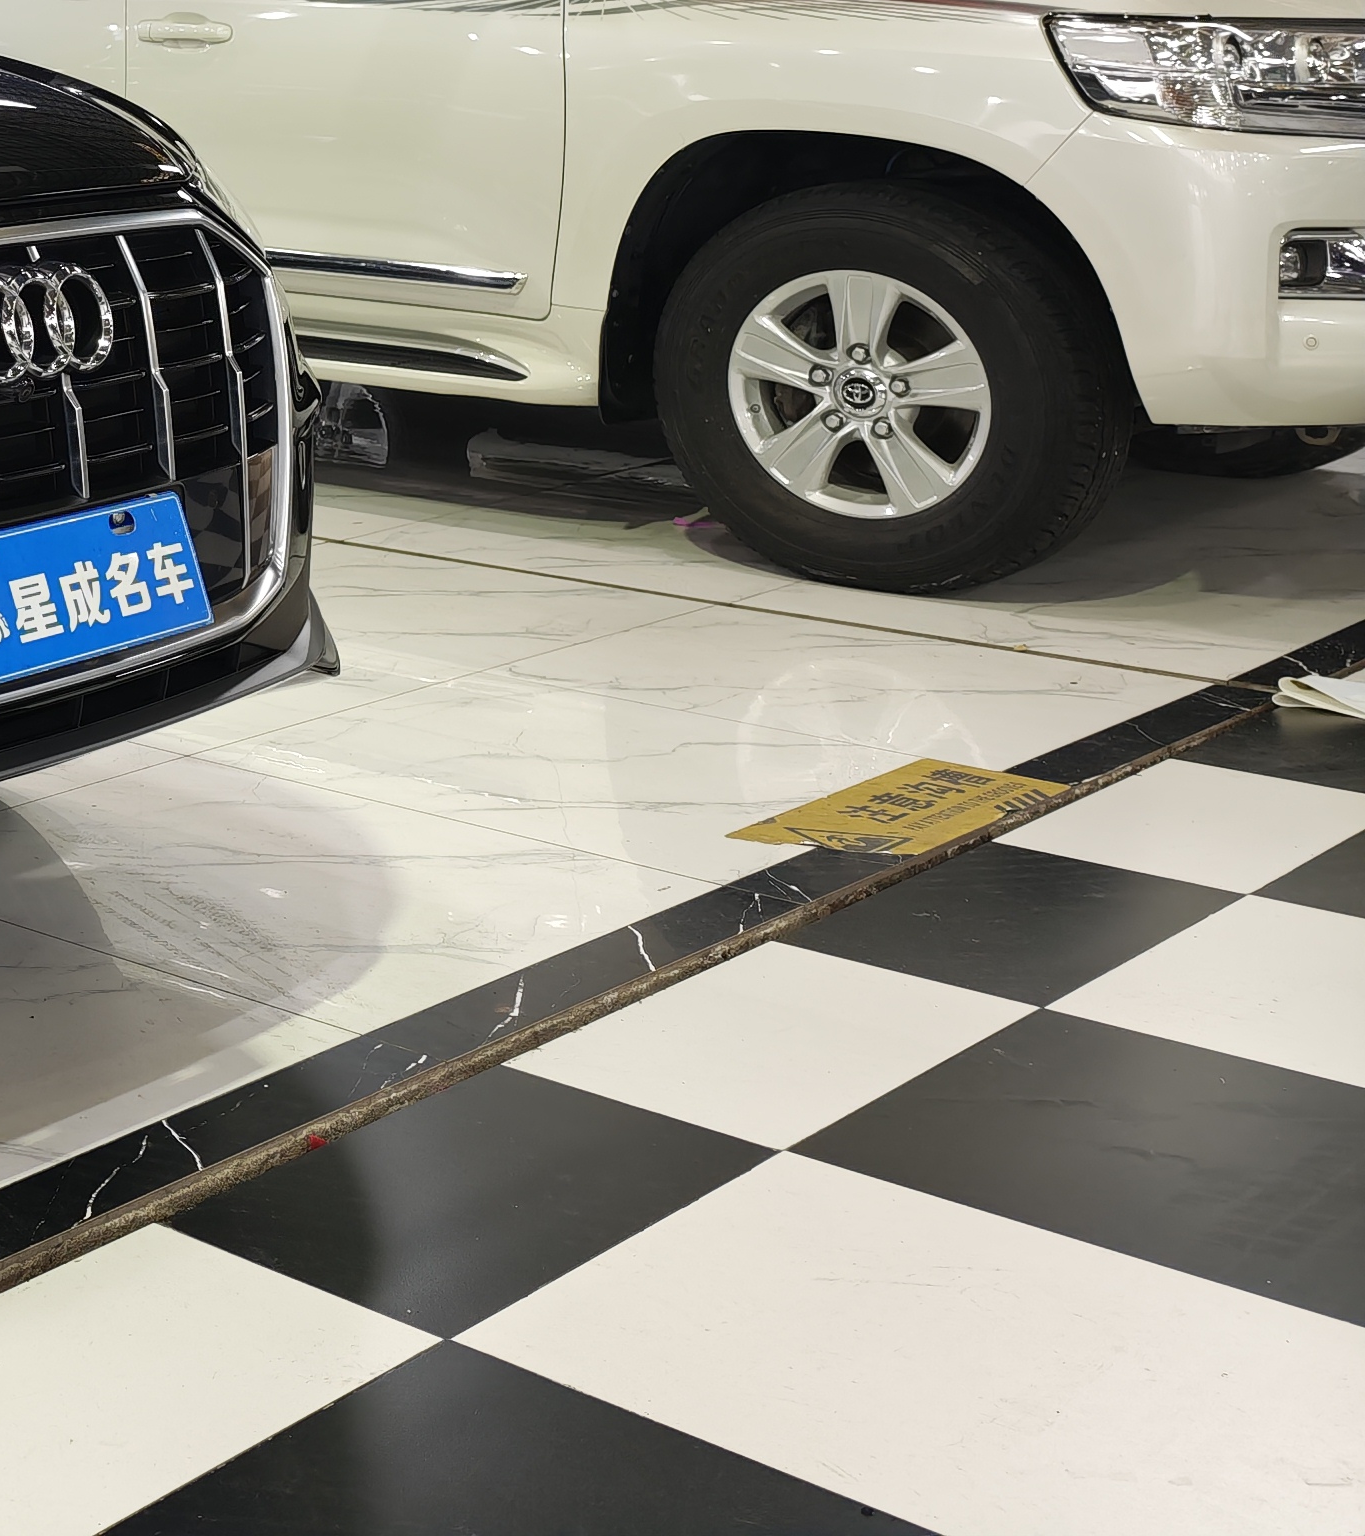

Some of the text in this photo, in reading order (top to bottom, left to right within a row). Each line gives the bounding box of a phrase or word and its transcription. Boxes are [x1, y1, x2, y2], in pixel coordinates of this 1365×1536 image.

[8, 541, 194, 644] 星成名车
[836, 767, 997, 825] 注意沟槽
